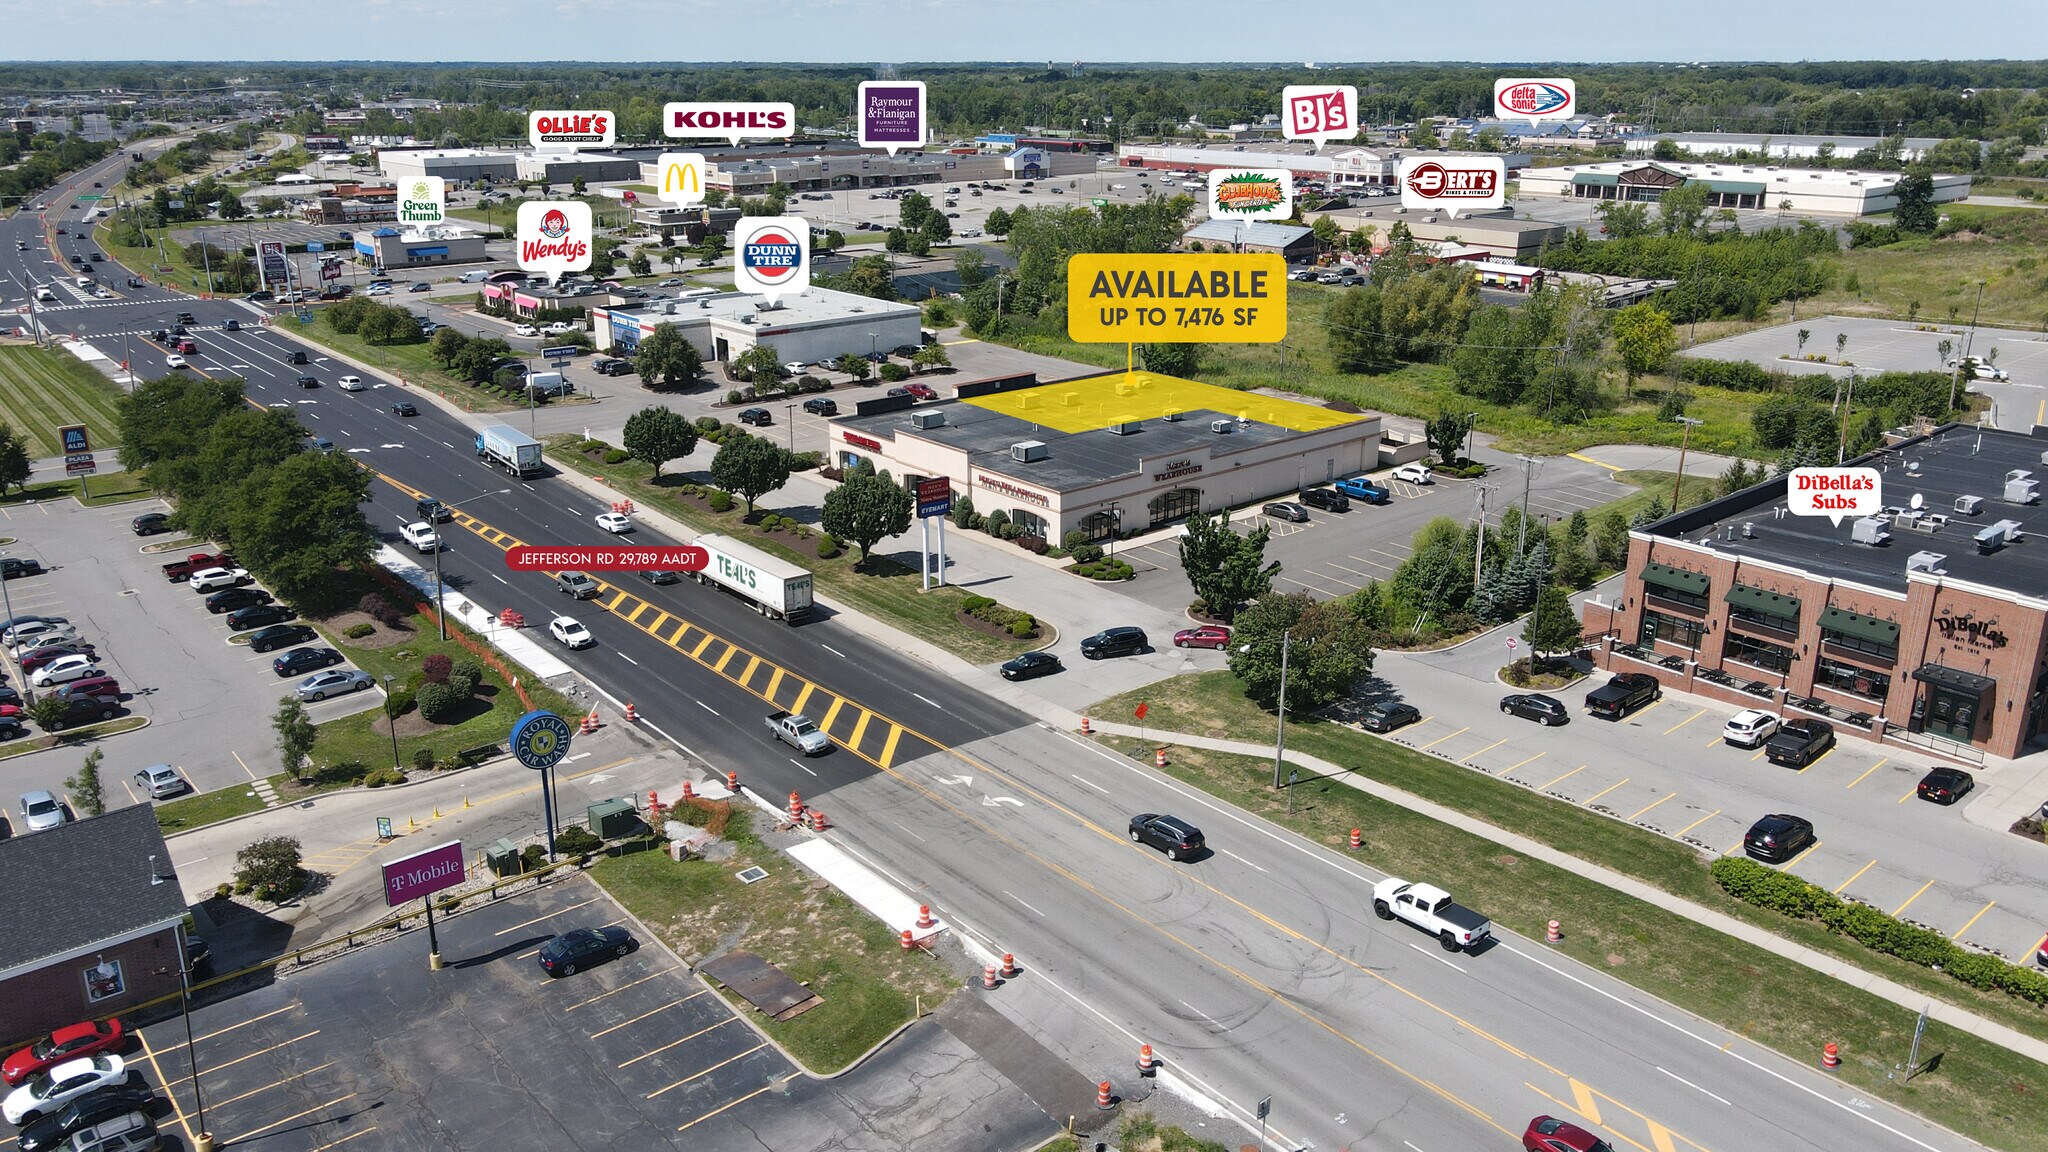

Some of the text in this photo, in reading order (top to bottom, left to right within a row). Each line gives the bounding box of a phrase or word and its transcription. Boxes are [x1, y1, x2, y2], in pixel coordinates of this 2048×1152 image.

[68, 442, 86, 450] ALDI
[717, 554, 757, 589] TEAL'S
[786, 580, 811, 591] TEAL'S
[1934, 616, 2009, 648] DiBella's
[522, 718, 563, 739] ROYAL
[519, 734, 568, 766] CAR WASH
